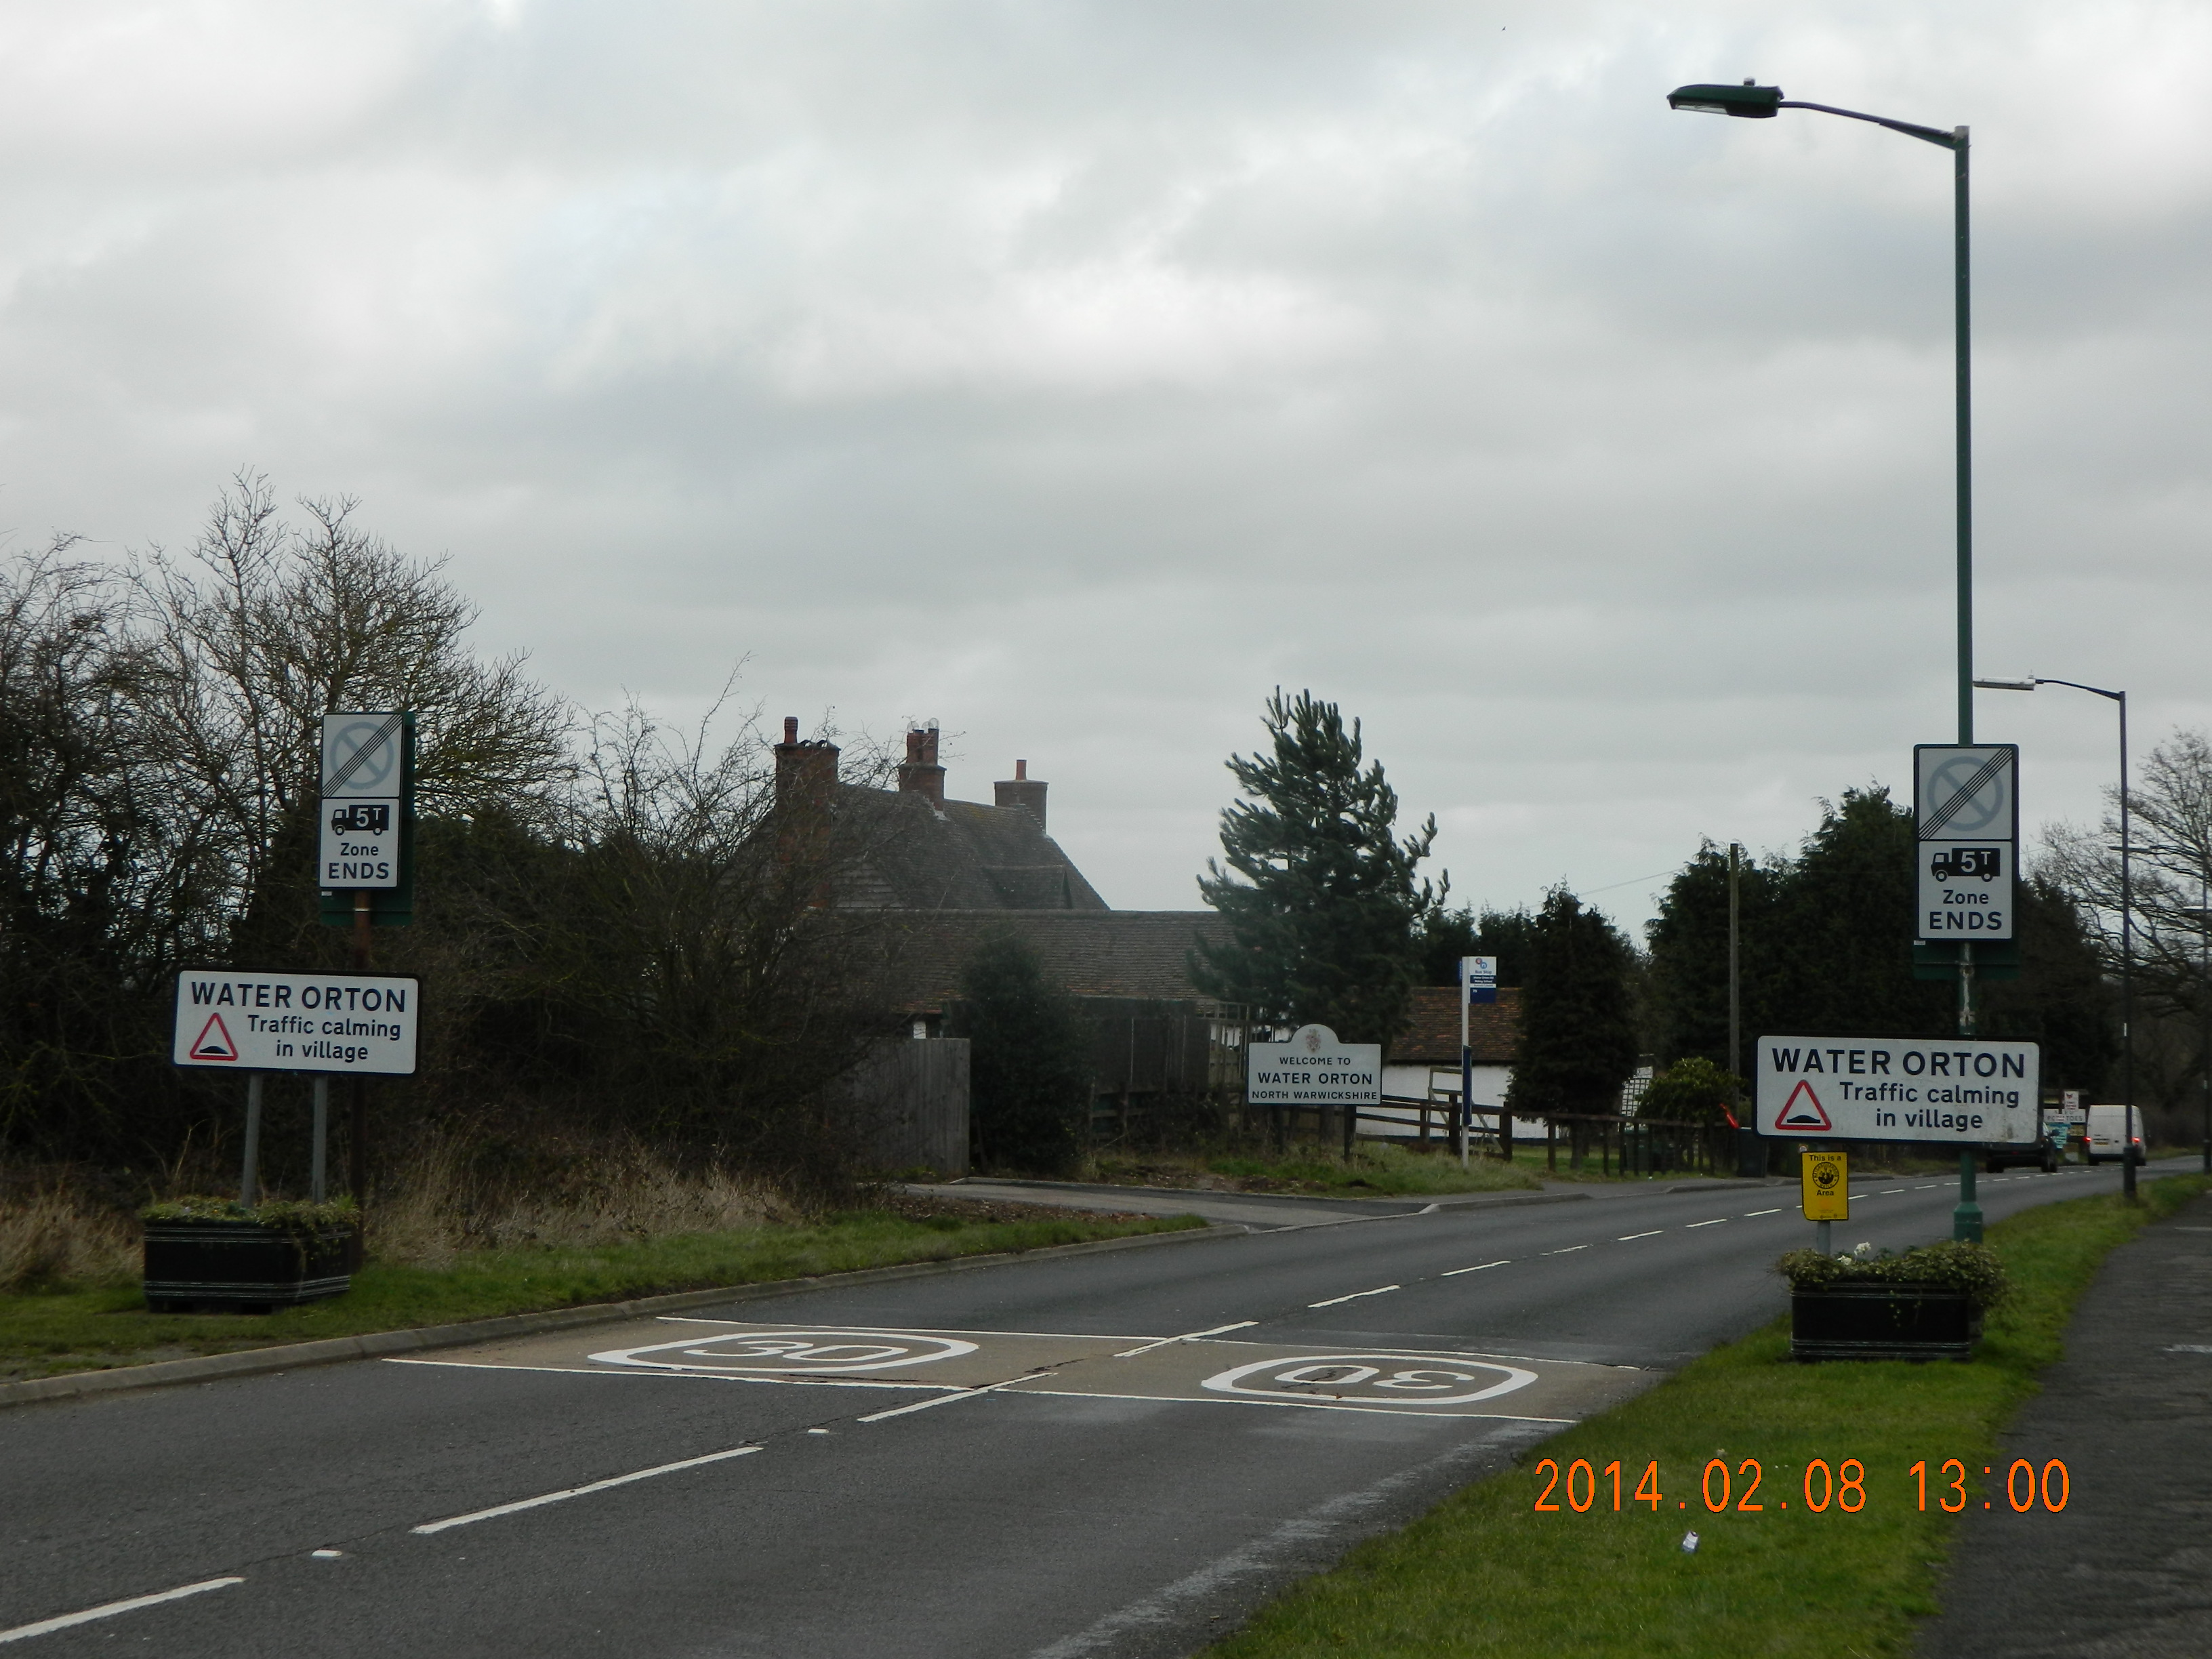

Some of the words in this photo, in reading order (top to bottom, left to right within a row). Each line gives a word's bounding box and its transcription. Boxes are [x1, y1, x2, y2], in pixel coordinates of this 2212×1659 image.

[340, 842, 379, 856] Zone
[328, 862, 389, 880] ENDS
[1942, 890, 1989, 904] Zone
[1929, 912, 2002, 930] ENDS
[191, 981, 291, 1008] WATER
[302, 986, 405, 1012] ORTON
[248, 1015, 314, 1034] Traffic
[322, 1018, 401, 1041] calming
[276, 1040, 293, 1057] in
[302, 1041, 369, 1063] village
[1279, 1057, 1332, 1065] WELCOME
[1337, 1057, 1351, 1065] TO
[1771, 1048, 1891, 1075] WATER
[1902, 1050, 2024, 1078] ORTON
[1258, 1072, 1311, 1084] WATER
[1318, 1073, 1372, 1084] ORTON
[1252, 1090, 1288, 1099] NORTH
[1294, 1091, 1377, 1100] WARWICKSHIRE
[1839, 1081, 1919, 1102] Traffic
[1927, 1084, 2020, 1109] calming
[1877, 1108, 1896, 1127] in
[1905, 1109, 1984, 1132] village
